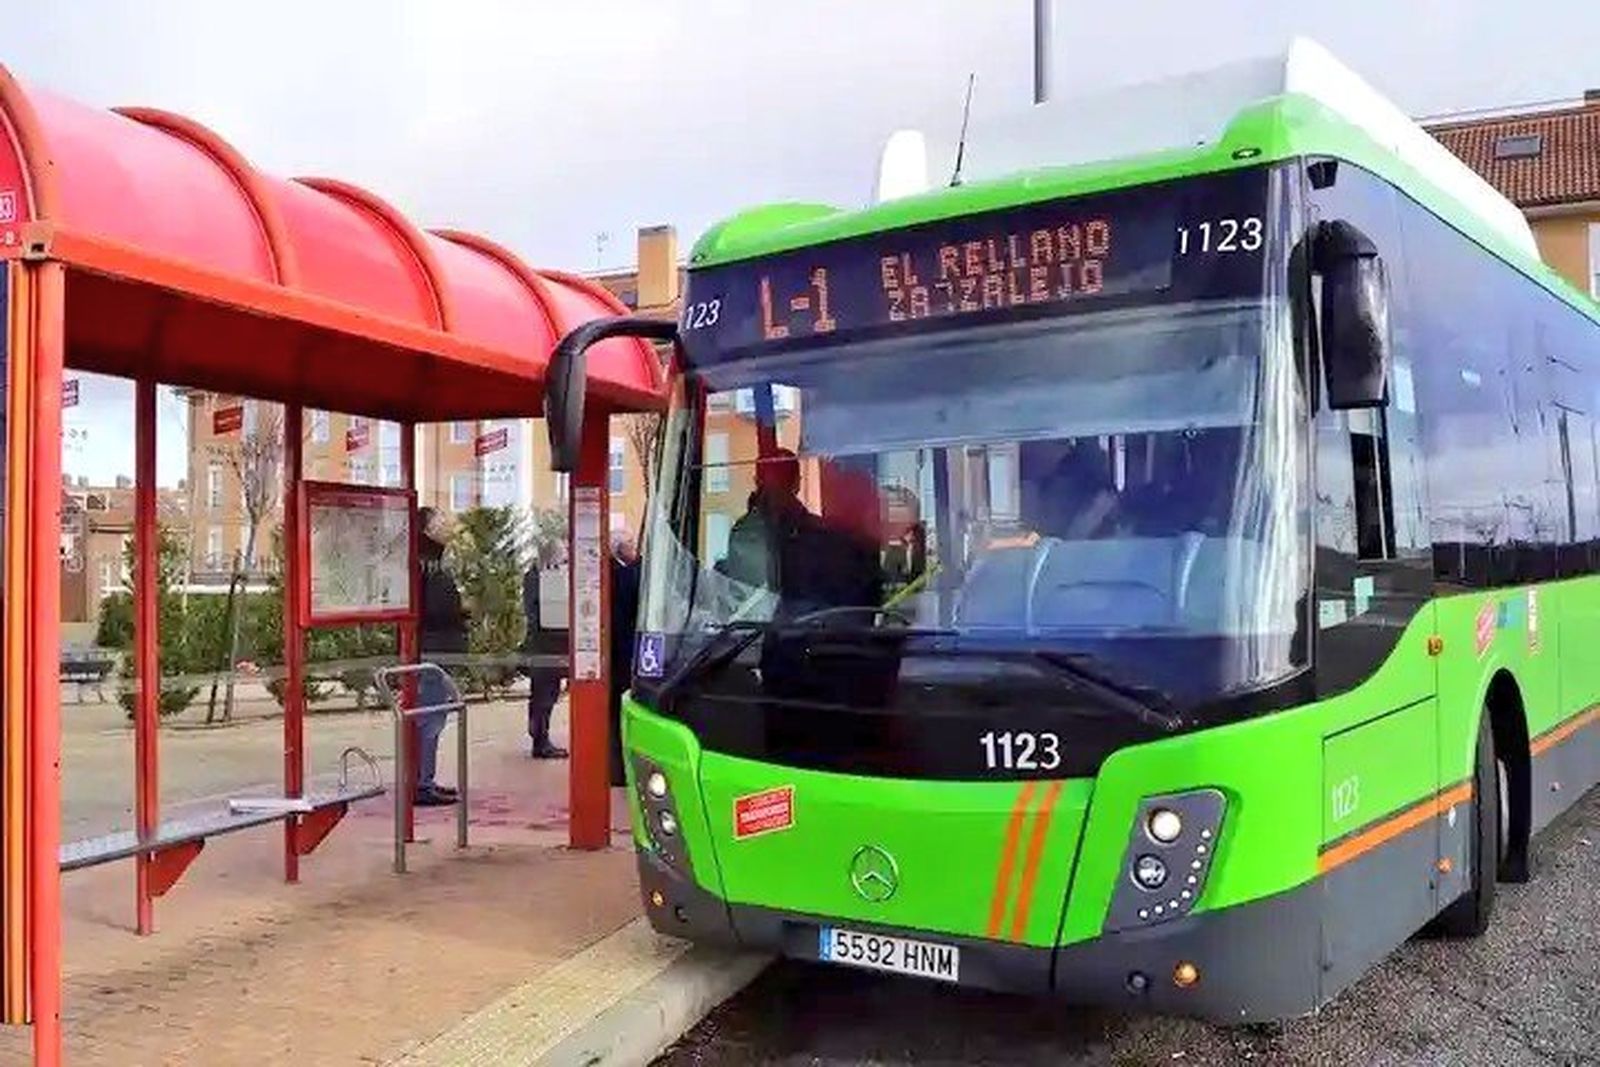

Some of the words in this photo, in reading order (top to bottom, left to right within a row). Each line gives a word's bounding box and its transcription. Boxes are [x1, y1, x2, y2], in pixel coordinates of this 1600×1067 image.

[881, 254, 918, 287] EL
[940, 219, 1110, 279] RELLANO
[1177, 217, 1262, 254] 1123
[761, 268, 836, 340] L-1
[979, 731, 1061, 770] 1123
[836, 932, 895, 966] 5592
[903, 942, 953, 976] HNM
